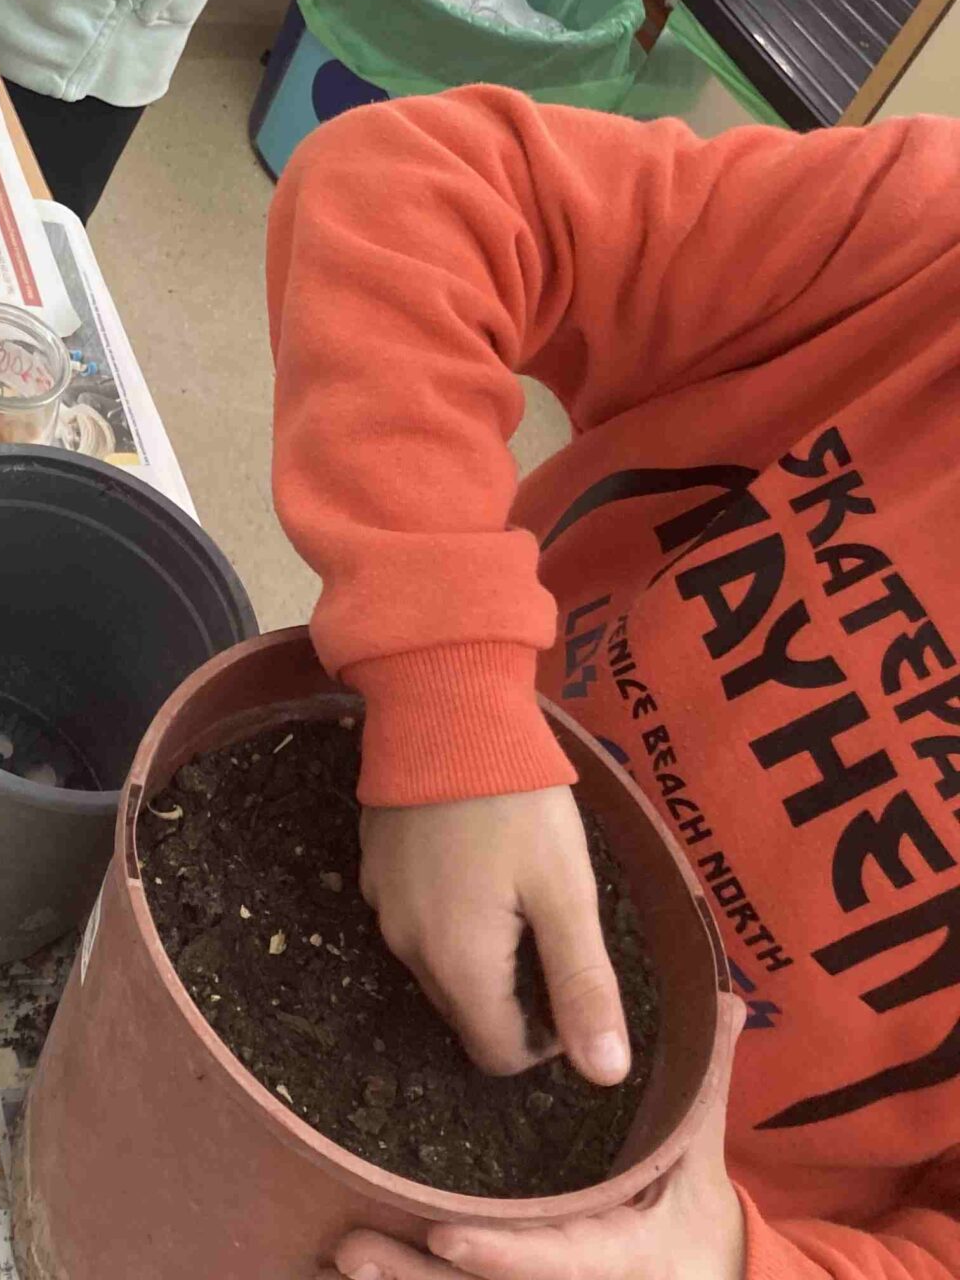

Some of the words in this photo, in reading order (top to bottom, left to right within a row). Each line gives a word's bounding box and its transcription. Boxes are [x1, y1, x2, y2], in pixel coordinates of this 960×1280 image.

[608, 613, 658, 719] ENICE
[642, 725, 712, 844] BEACH
[698, 851, 793, 972] NORTH
[779, 426, 960, 824] SKATEPA
